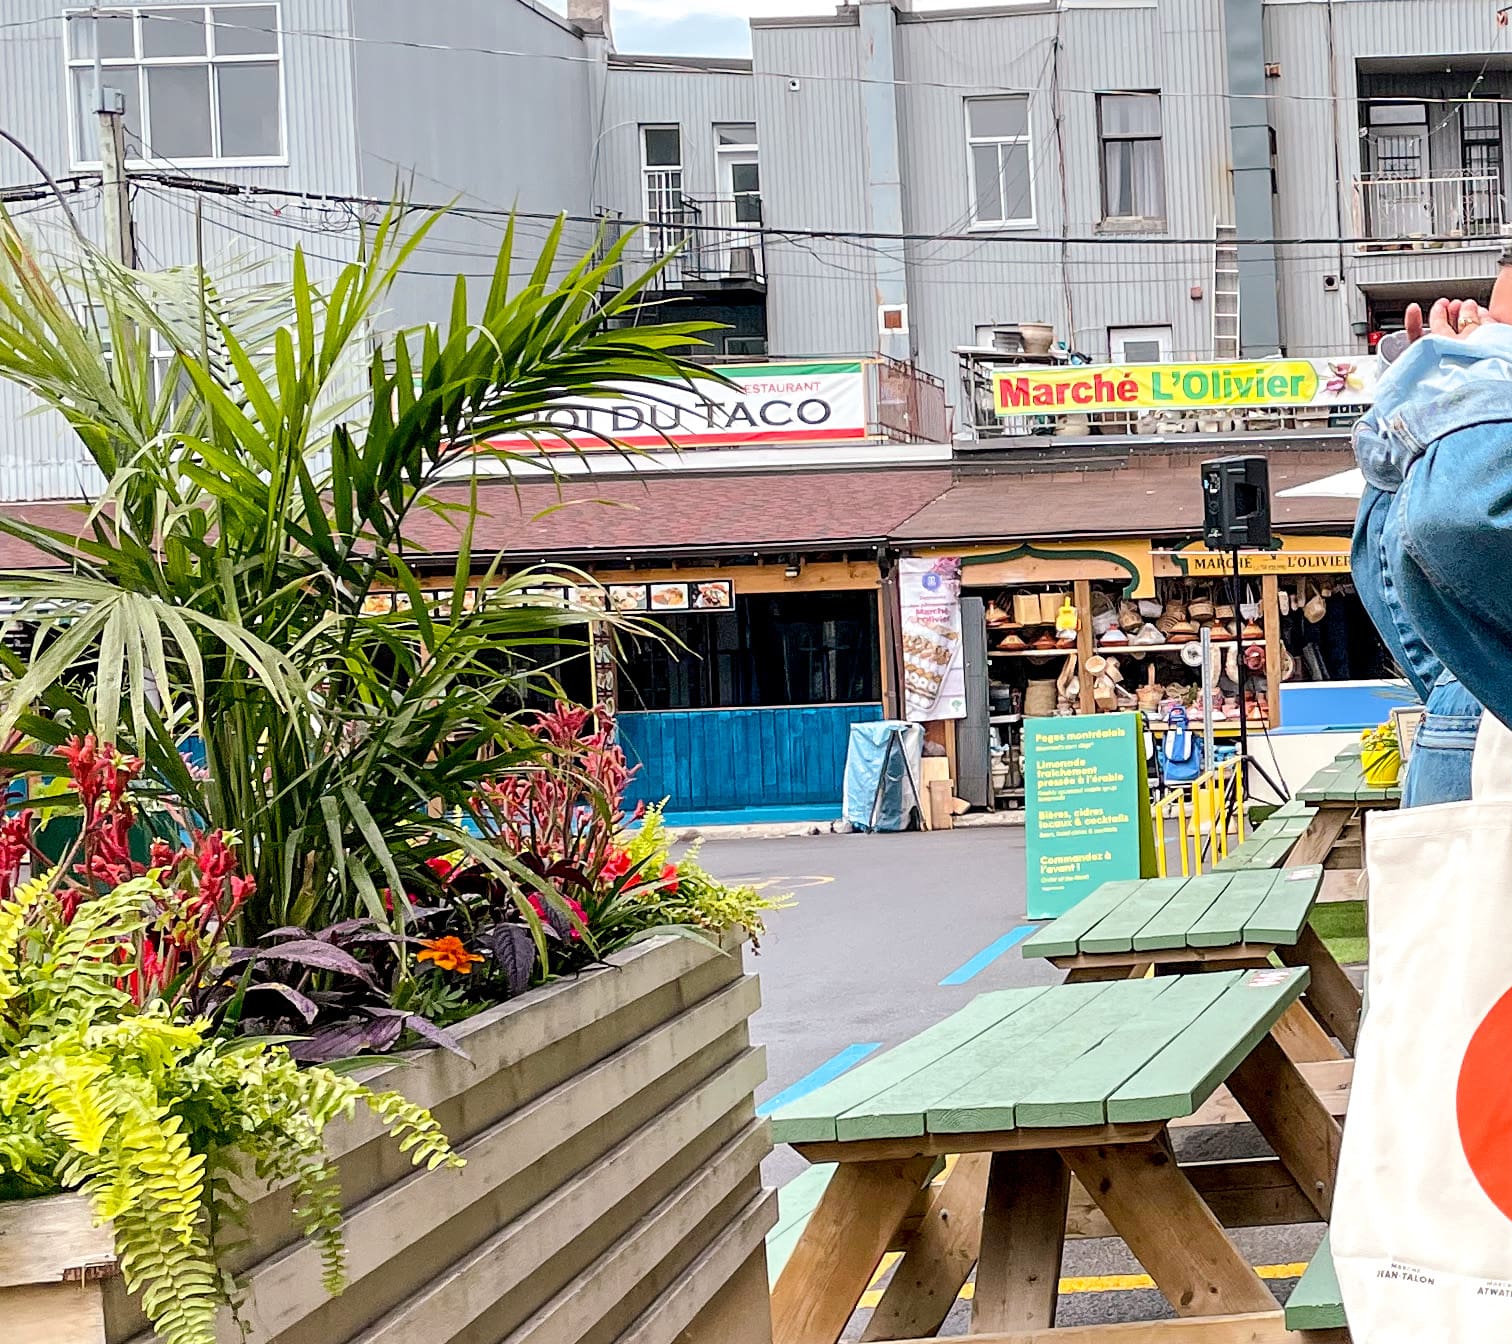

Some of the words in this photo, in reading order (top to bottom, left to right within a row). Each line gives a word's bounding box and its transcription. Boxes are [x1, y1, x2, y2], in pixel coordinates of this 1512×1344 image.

[736, 381, 821, 395] ESTAURANT
[1000, 372, 1139, 408] Marché
[1152, 369, 1306, 401] L'Olivier
[612, 404, 681, 431] DU
[695, 398, 831, 428] TACO
[1036, 758, 1086, 770] Limonade
[1376, 1270, 1435, 1286] JEAN-TALON
